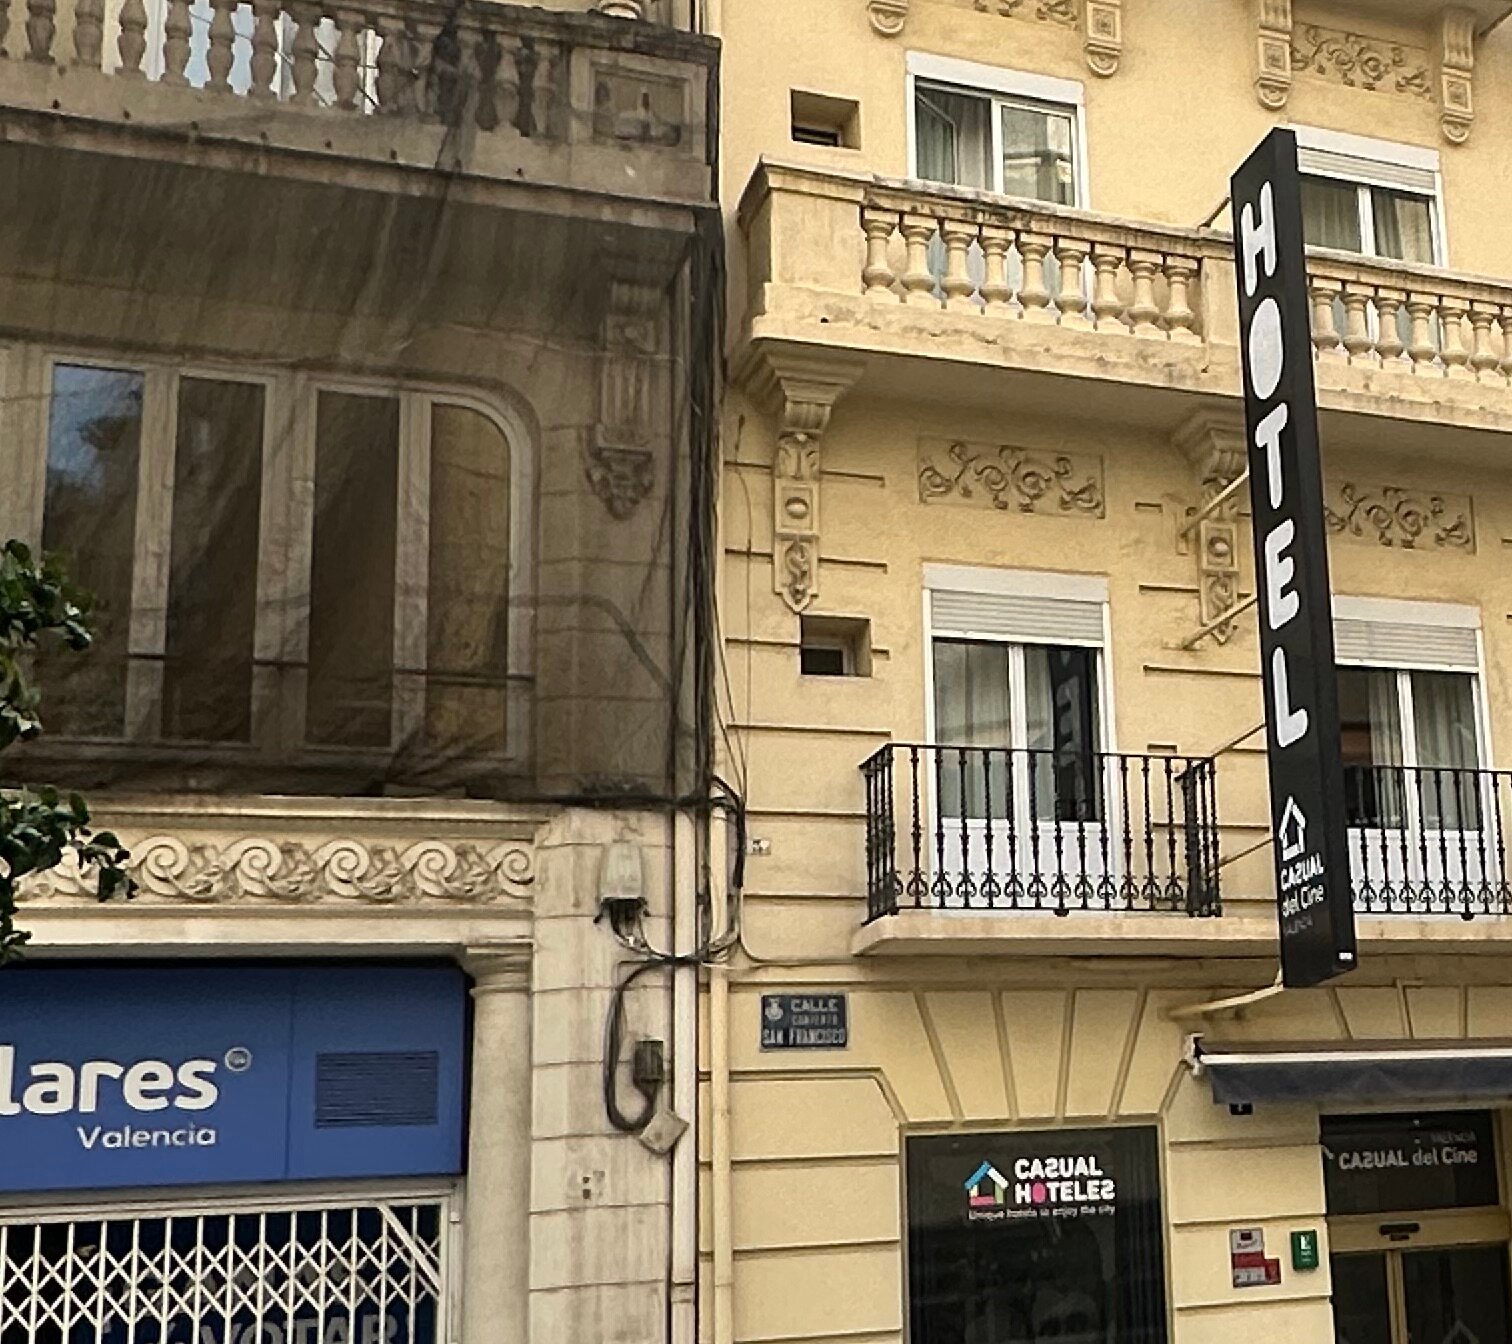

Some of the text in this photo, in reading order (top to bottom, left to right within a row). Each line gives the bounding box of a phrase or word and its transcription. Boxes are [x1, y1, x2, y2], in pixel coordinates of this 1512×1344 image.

[1240, 179, 1309, 749] HOTEL
[790, 998, 839, 1012] CALLE
[77, 1122, 216, 1149] Valencia
[1014, 1156, 1104, 1180] CASUAL
[1338, 1146, 1410, 1170] CASUAL
